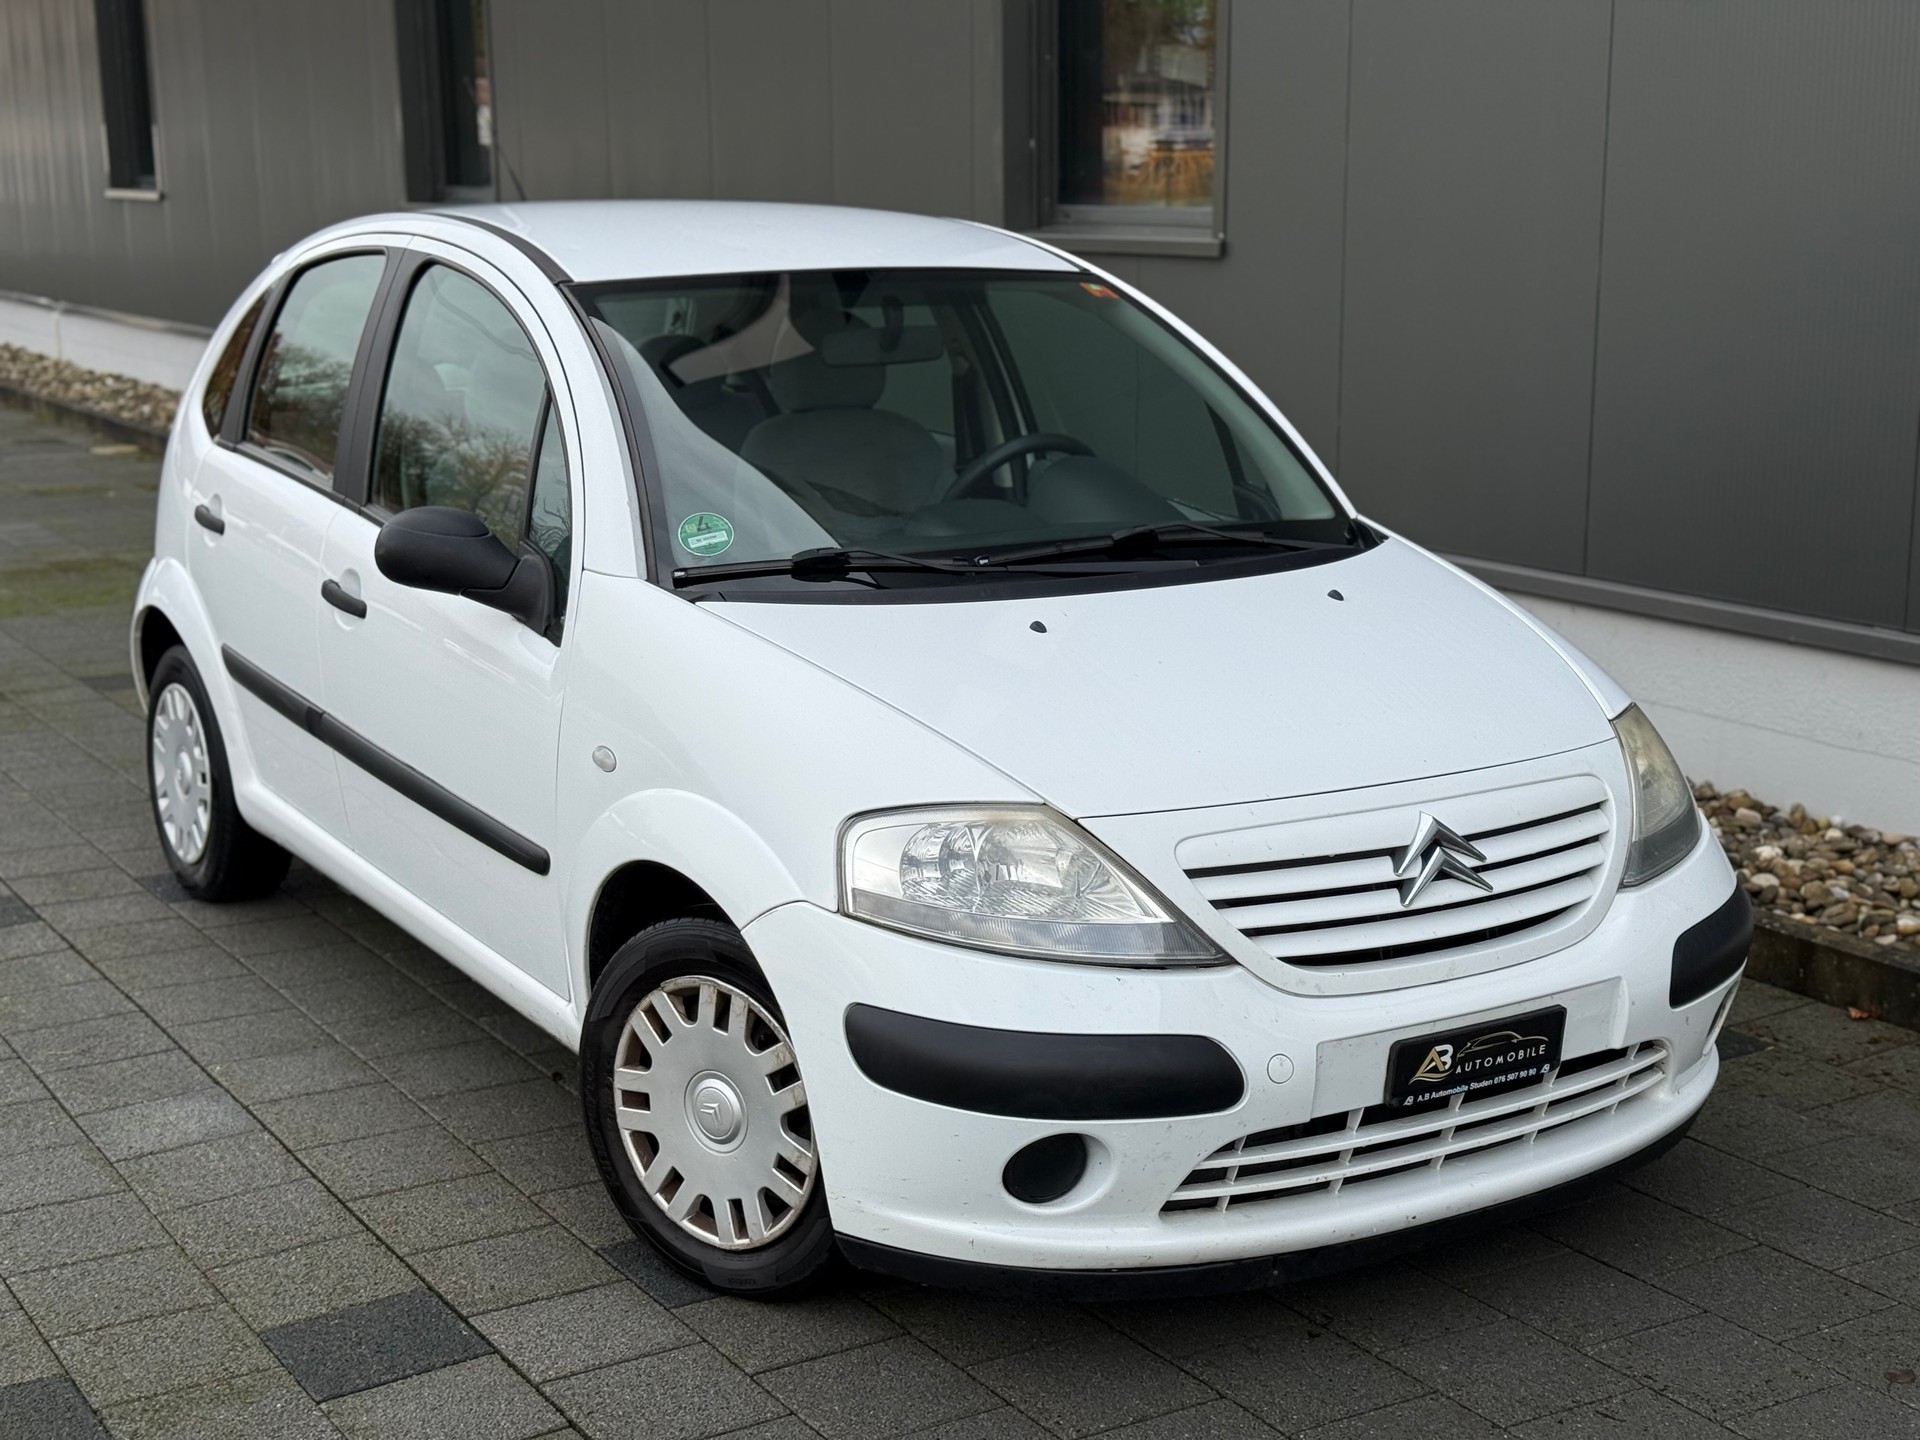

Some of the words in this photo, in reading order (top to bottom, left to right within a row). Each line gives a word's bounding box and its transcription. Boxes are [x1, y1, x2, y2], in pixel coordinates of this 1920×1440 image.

[1455, 1044, 1546, 1074] AUTOMOBILE
[1417, 1093, 1430, 1103] A.B
[1431, 1085, 1469, 1099] Automobile
[1493, 1076, 1505, 1084] 076
[1506, 1072, 1519, 1081] 507
[1519, 1069, 1528, 1078] 90
[1528, 1067, 1537, 1076] 90
